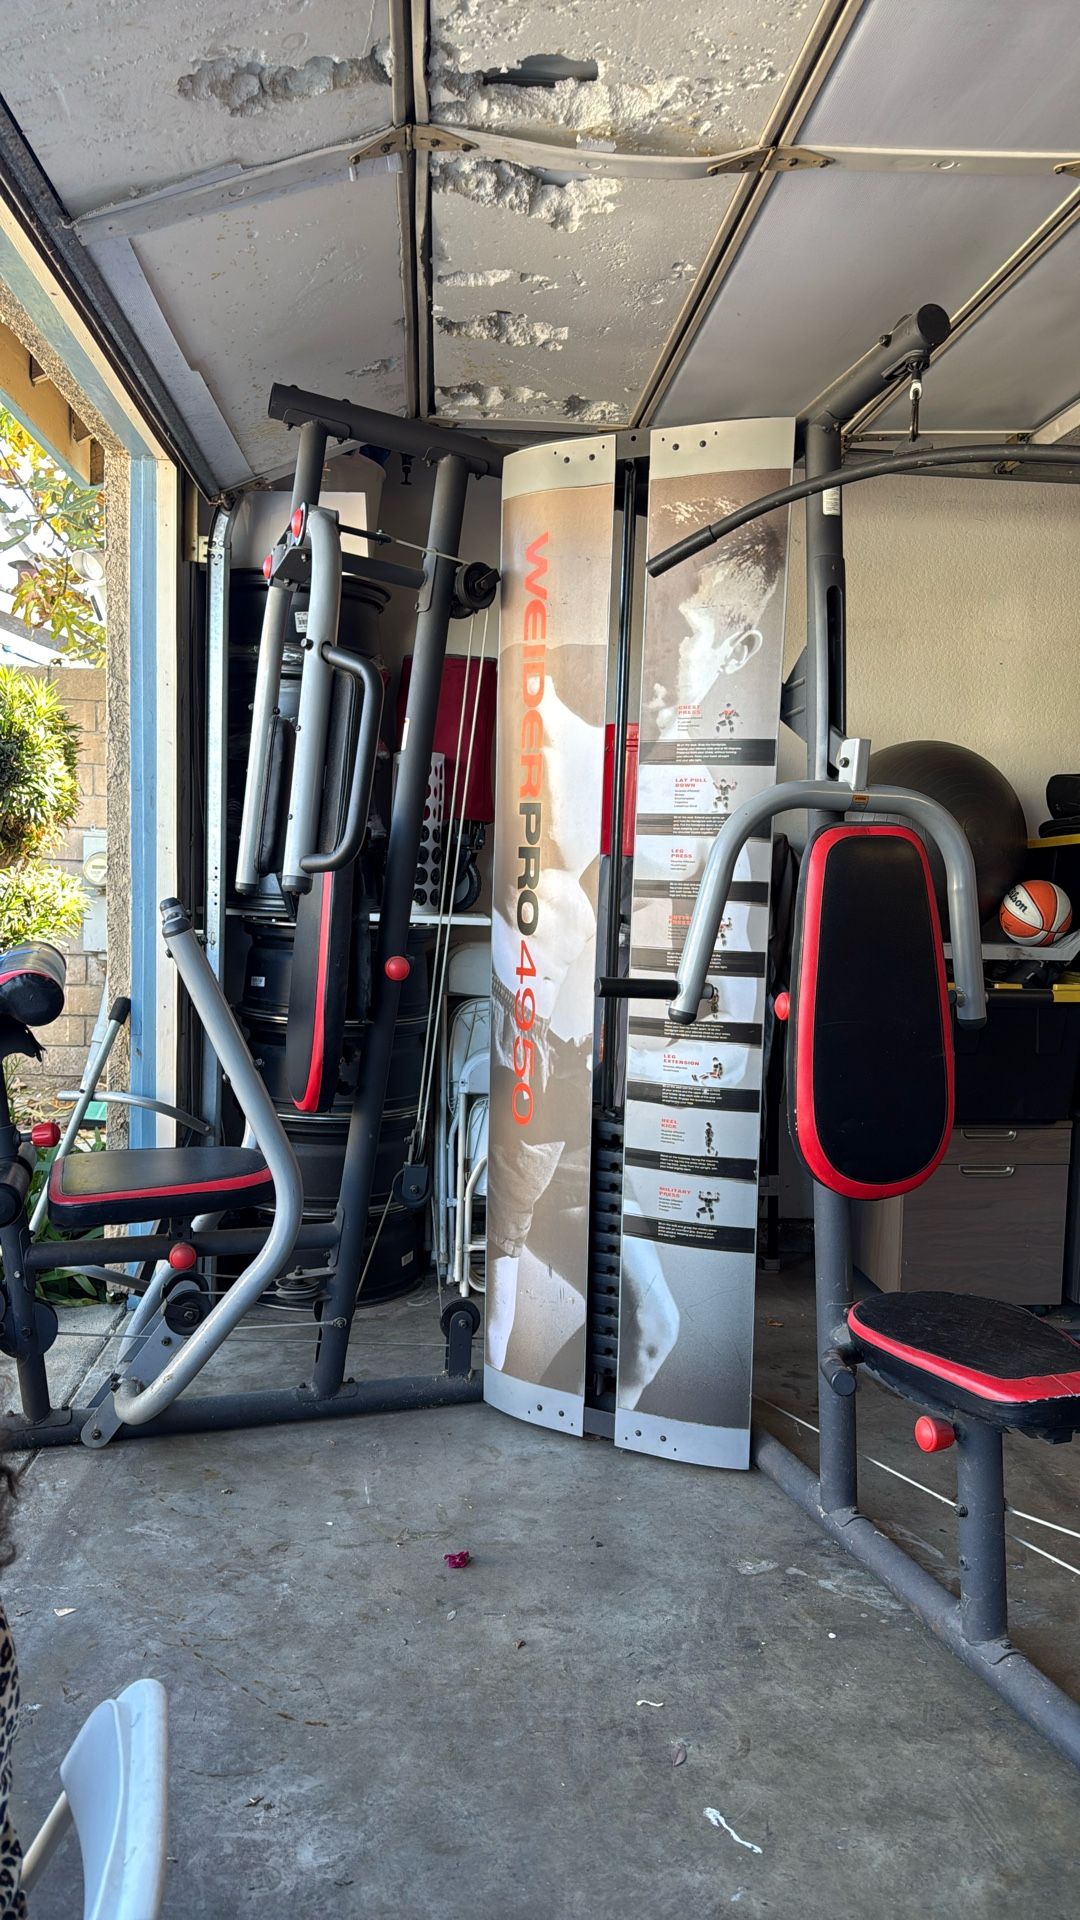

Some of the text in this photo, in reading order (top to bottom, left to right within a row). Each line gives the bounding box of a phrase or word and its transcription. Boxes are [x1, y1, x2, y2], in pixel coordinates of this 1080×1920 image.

[512, 531, 549, 1127] WEIDER PRO 4950
[663, 1058, 700, 1066] EXTENSION
[659, 1186, 692, 1195] MILITARY
